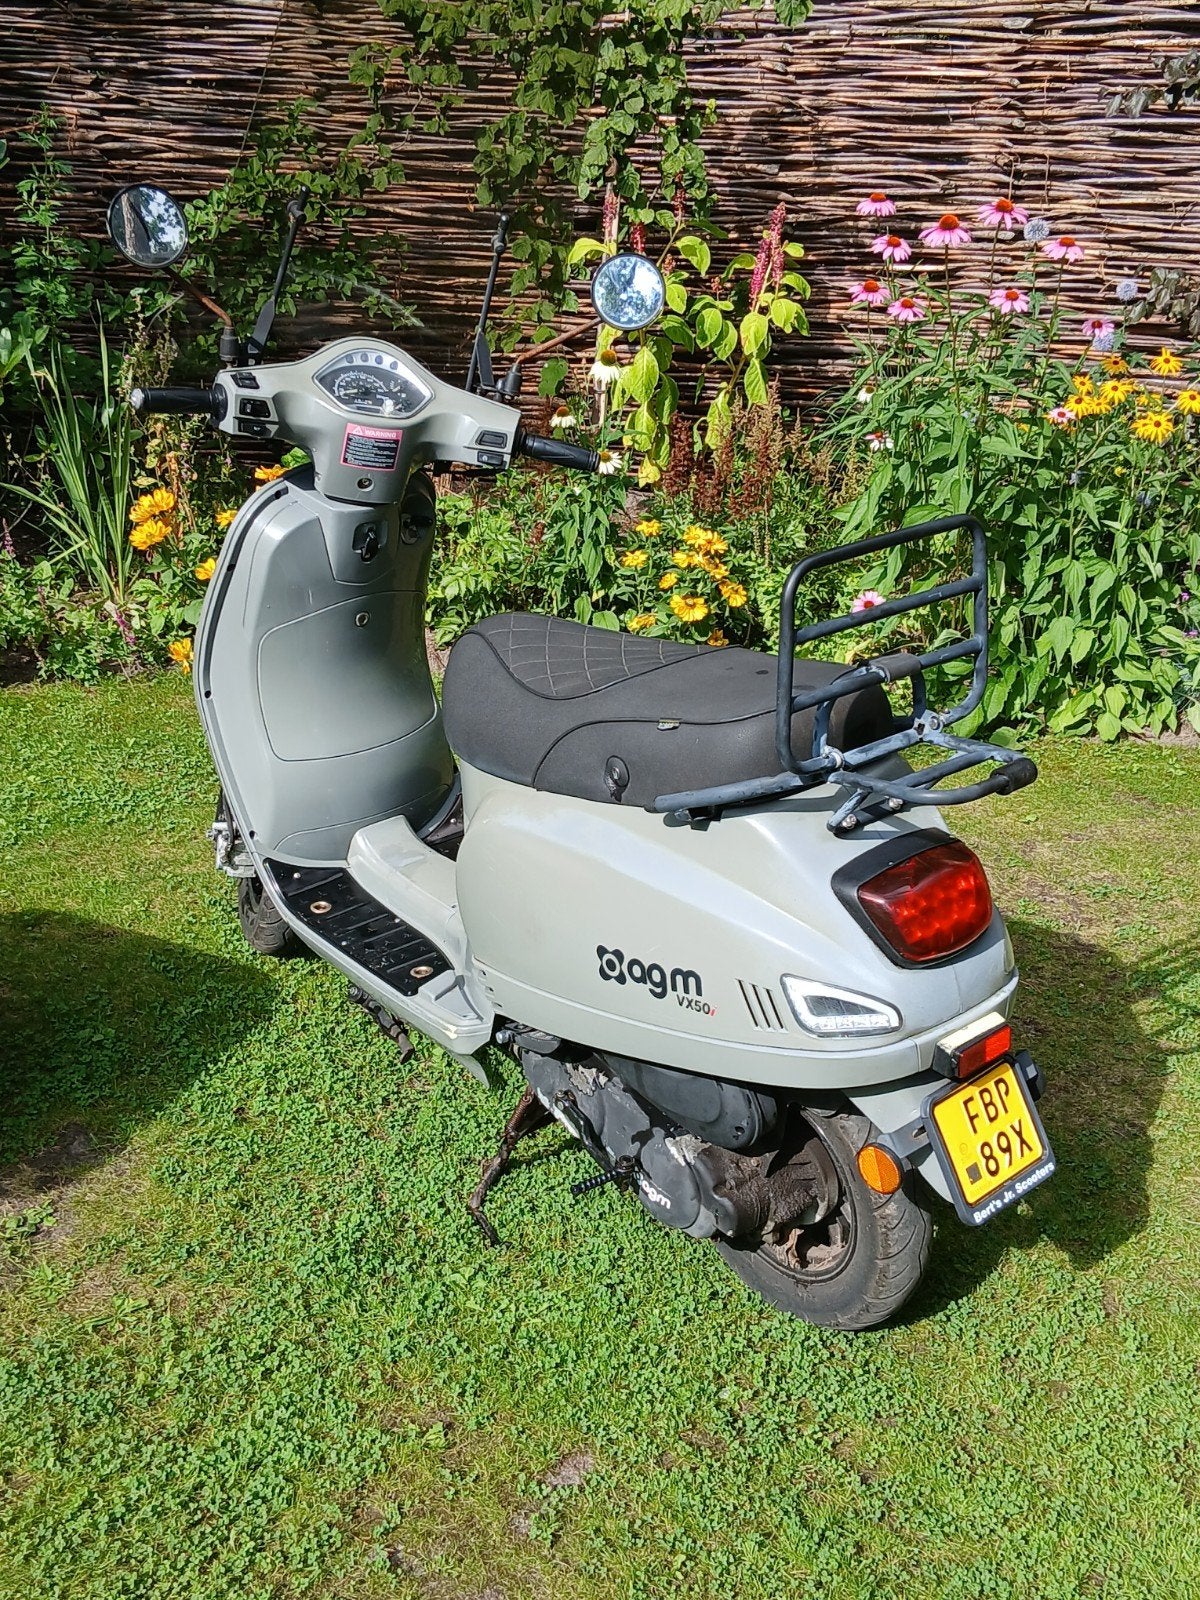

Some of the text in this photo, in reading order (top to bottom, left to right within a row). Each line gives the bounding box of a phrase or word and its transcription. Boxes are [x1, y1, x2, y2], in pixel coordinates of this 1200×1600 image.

[364, 428, 397, 438] WARNING
[627, 958, 703, 1000] agm
[962, 1077, 1010, 1135] FBP
[980, 1118, 1034, 1178] 89X
[641, 1180, 671, 1210] agm
[972, 1162, 1055, 1224] Bert's Jr. Scooters
